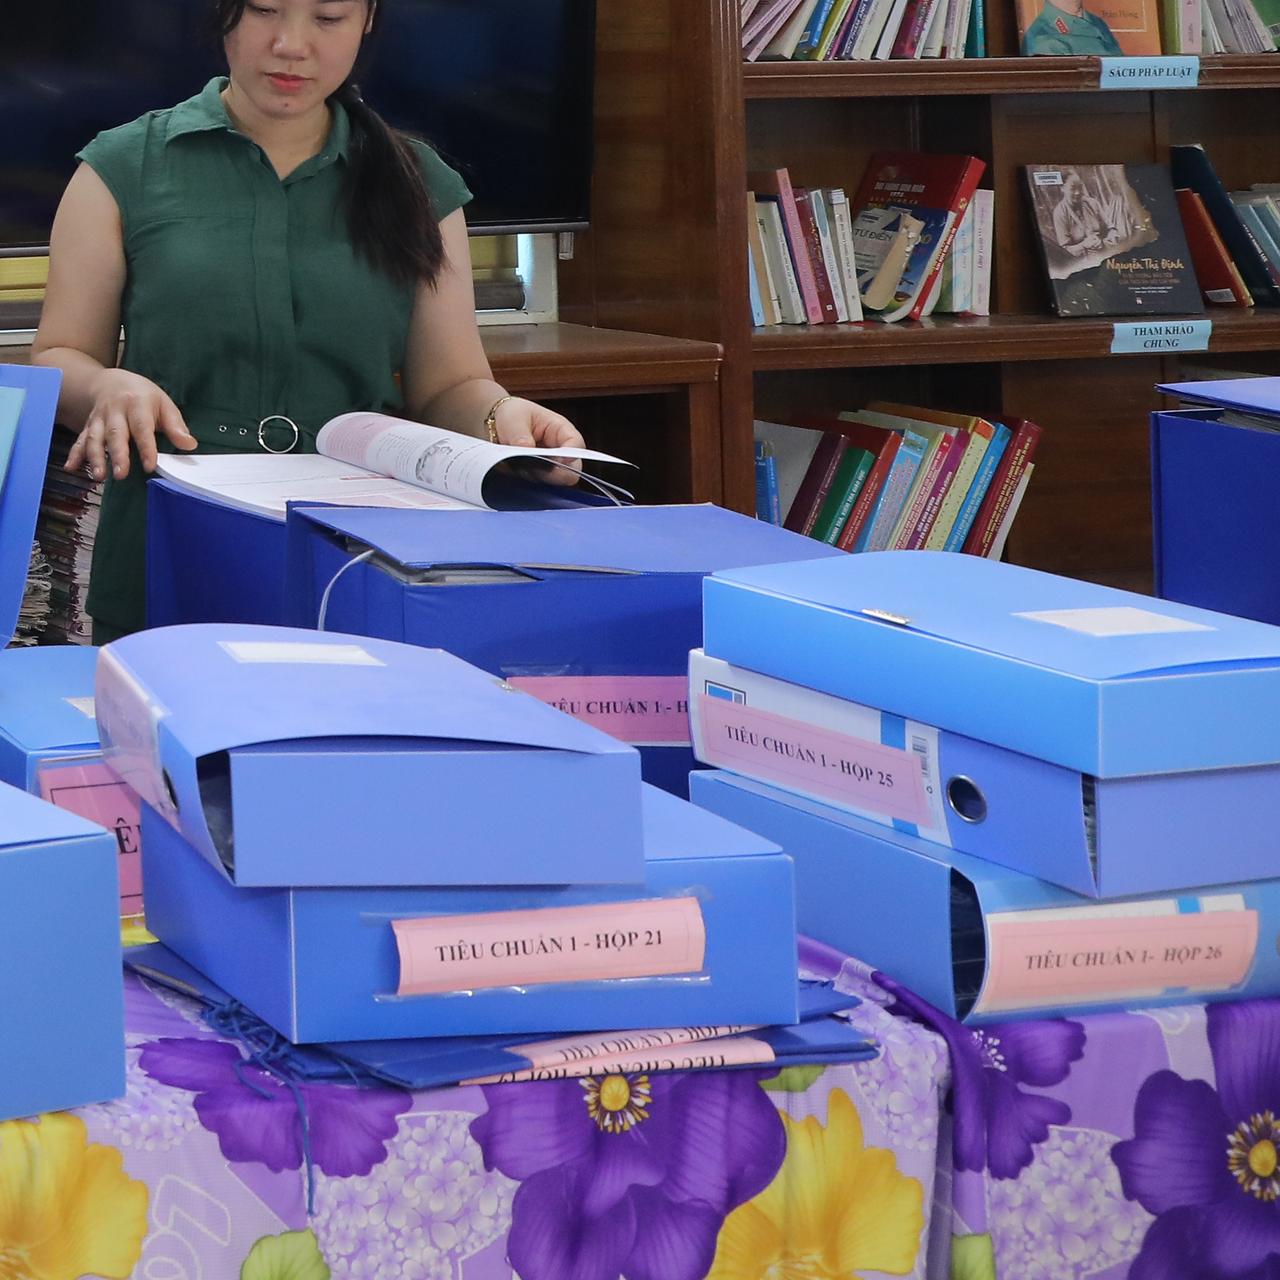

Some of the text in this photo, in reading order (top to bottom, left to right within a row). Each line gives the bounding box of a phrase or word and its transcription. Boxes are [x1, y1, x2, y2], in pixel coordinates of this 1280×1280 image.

[1109, 66, 1192, 78] SÁCH PHÁP LUẬT
[1132, 324, 1194, 337] THAM KHẢO
[1143, 338, 1179, 349] CHUNG
[725, 723, 759, 748] TIÊU
[820, 754, 827, 767] 1
[840, 759, 873, 783] HỘP
[877, 771, 894, 787] 25
[435, 939, 484, 962] TIÊU
[570, 935, 577, 951] 1
[596, 929, 639, 952] HỘP
[645, 930, 663, 946] 21
[1025, 950, 1068, 971] TIÊU
[1164, 945, 1202, 964] HỘP
[1204, 946, 1224, 961] 26
